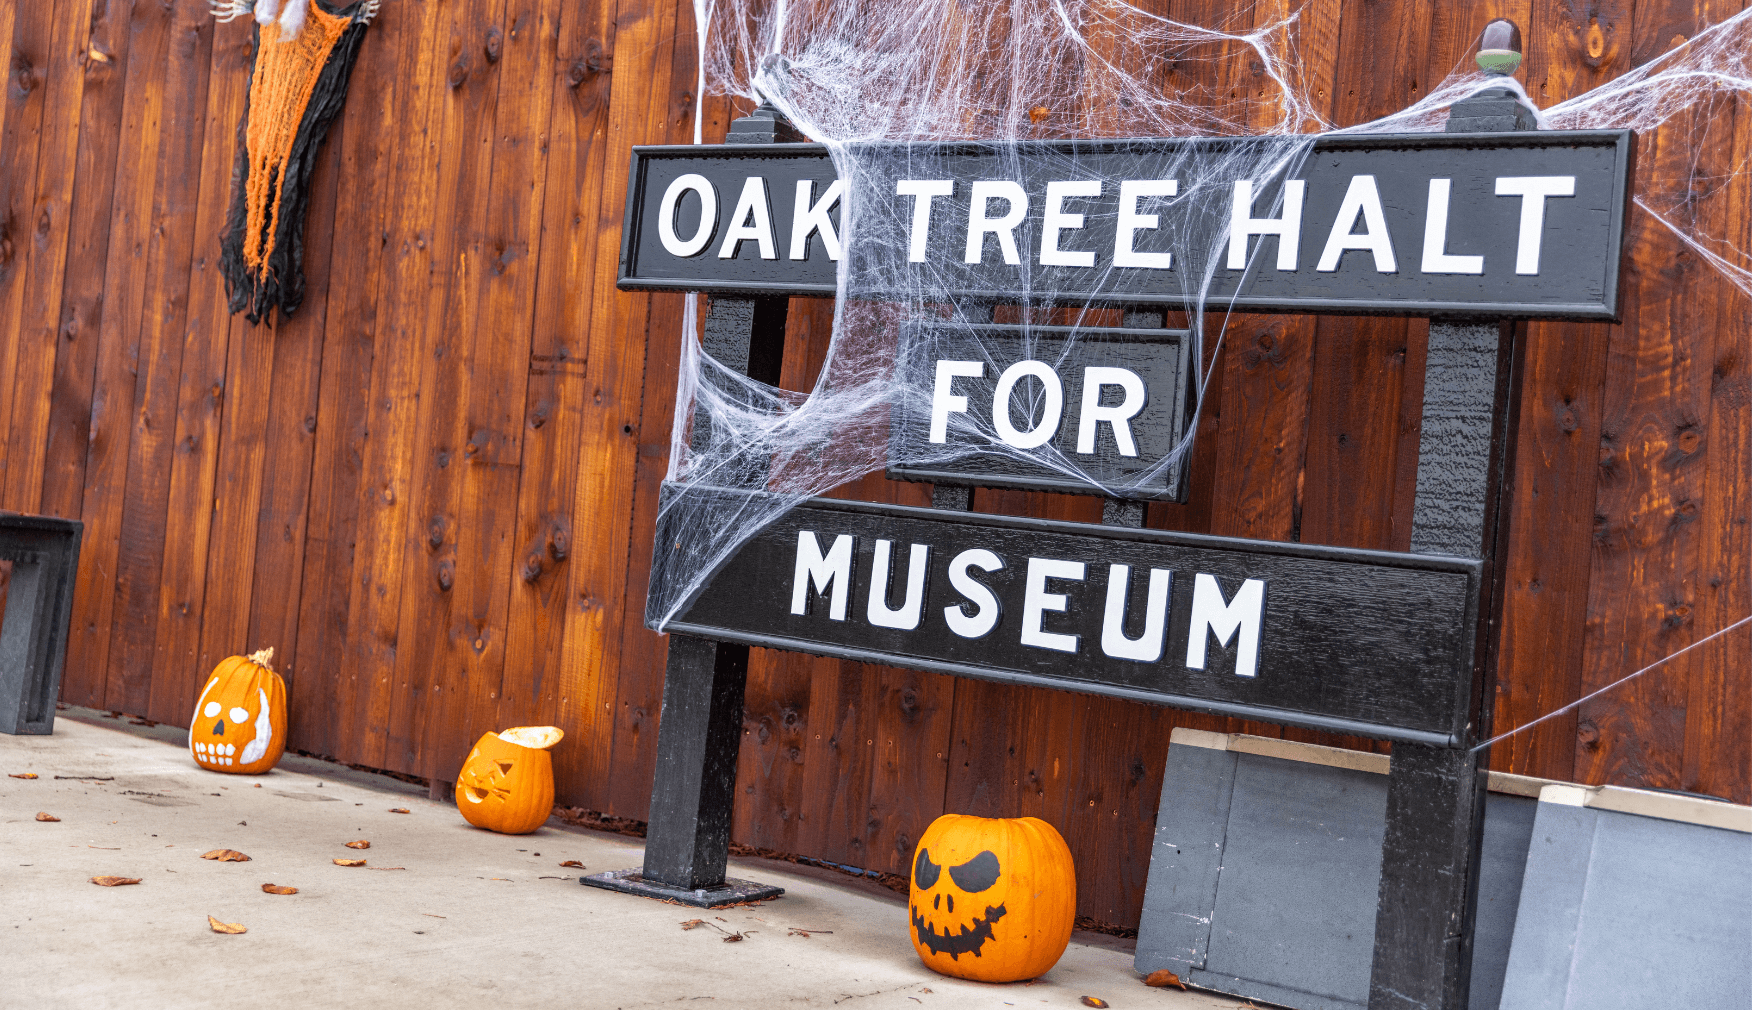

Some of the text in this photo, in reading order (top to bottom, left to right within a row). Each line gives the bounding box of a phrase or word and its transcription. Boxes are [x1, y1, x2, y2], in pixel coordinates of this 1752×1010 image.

[658, 173, 1576, 276] OAK TREE HALT
[929, 359, 1148, 458] FOR
[790, 530, 1266, 678] MUSEUM
